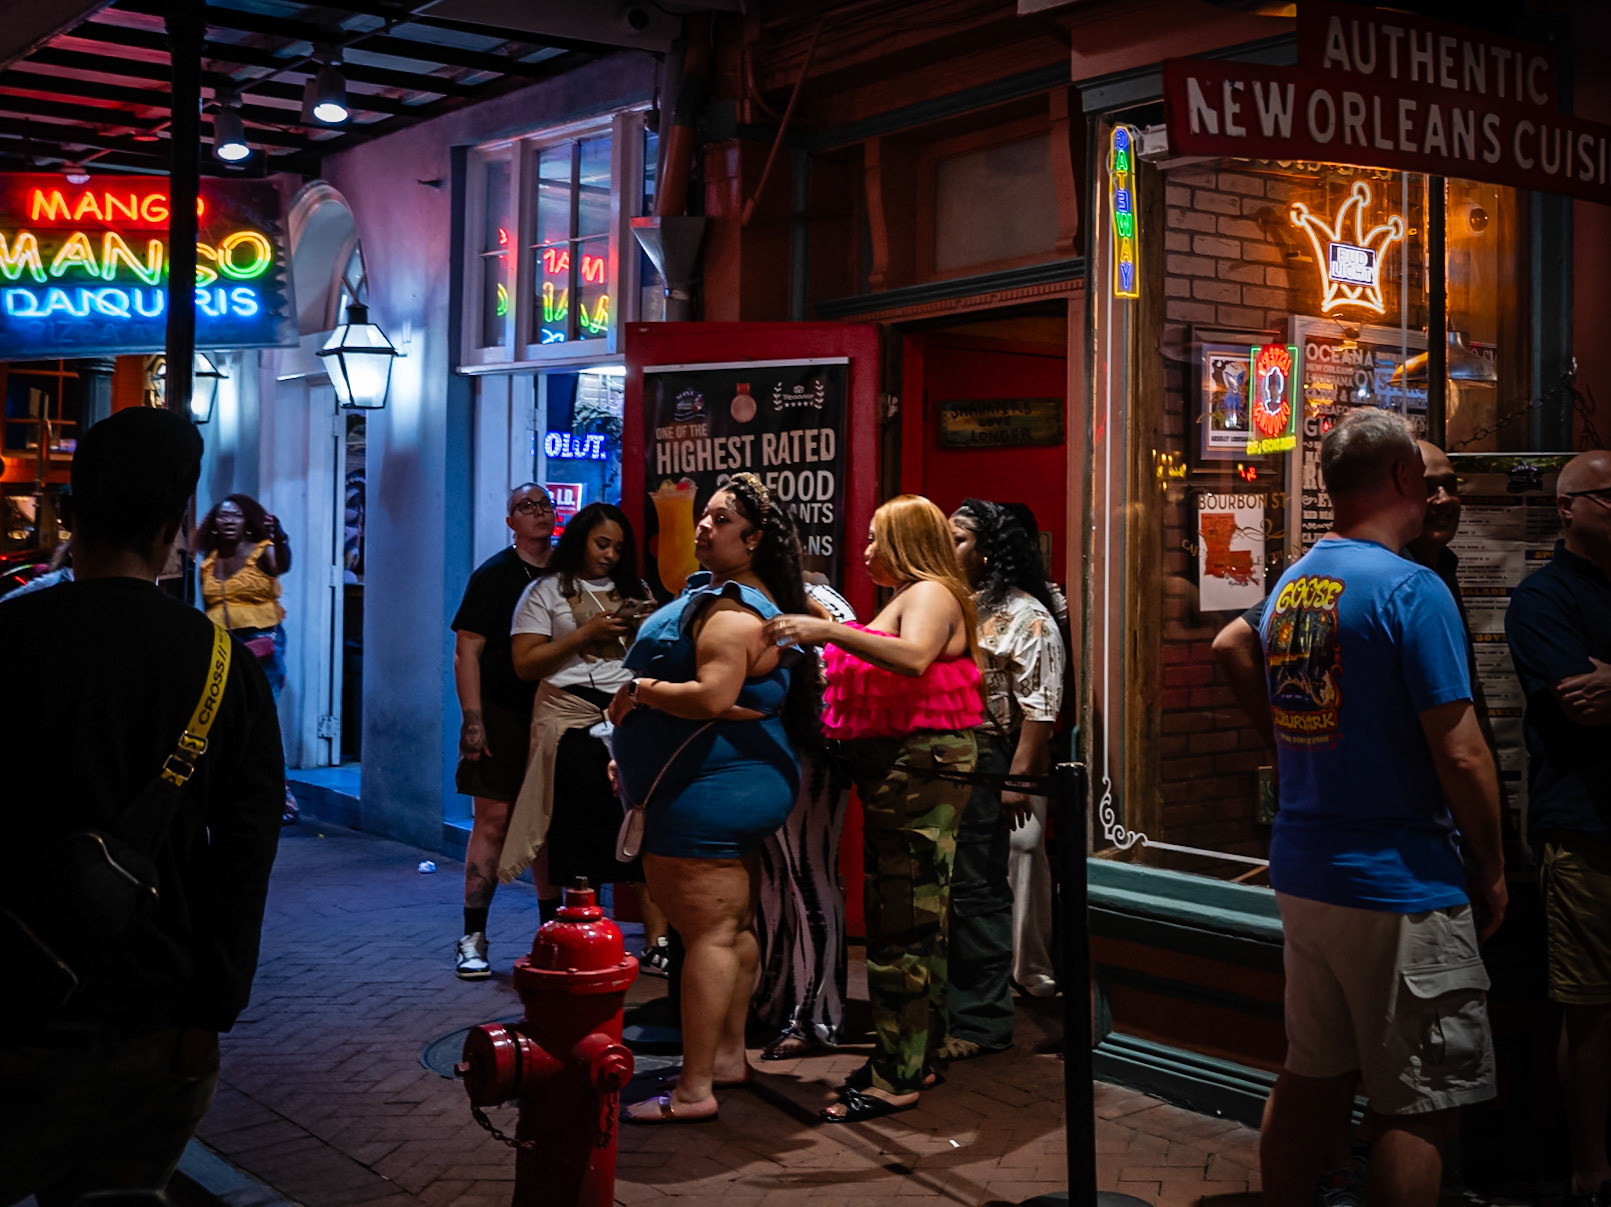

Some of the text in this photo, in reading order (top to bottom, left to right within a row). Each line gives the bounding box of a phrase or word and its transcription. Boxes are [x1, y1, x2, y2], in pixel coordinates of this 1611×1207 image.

[1323, 15, 1549, 105] AUTHENTIC
[1186, 77, 1611, 185] NEW ORLEANS CUISI
[31, 189, 204, 222] MANG
[1331, 262, 1374, 283] LIGHT
[1337, 247, 1369, 268] BUD
[6, 287, 258, 318] DAIQURIS
[1305, 343, 1374, 367] OCEANA
[656, 423, 708, 440] ONE OF THE
[656, 428, 836, 475] HIGHEST RATED
[717, 470, 835, 501] FOOD
[1199, 494, 1267, 510] BOURBON
[1275, 577, 1343, 614] GOOSE
